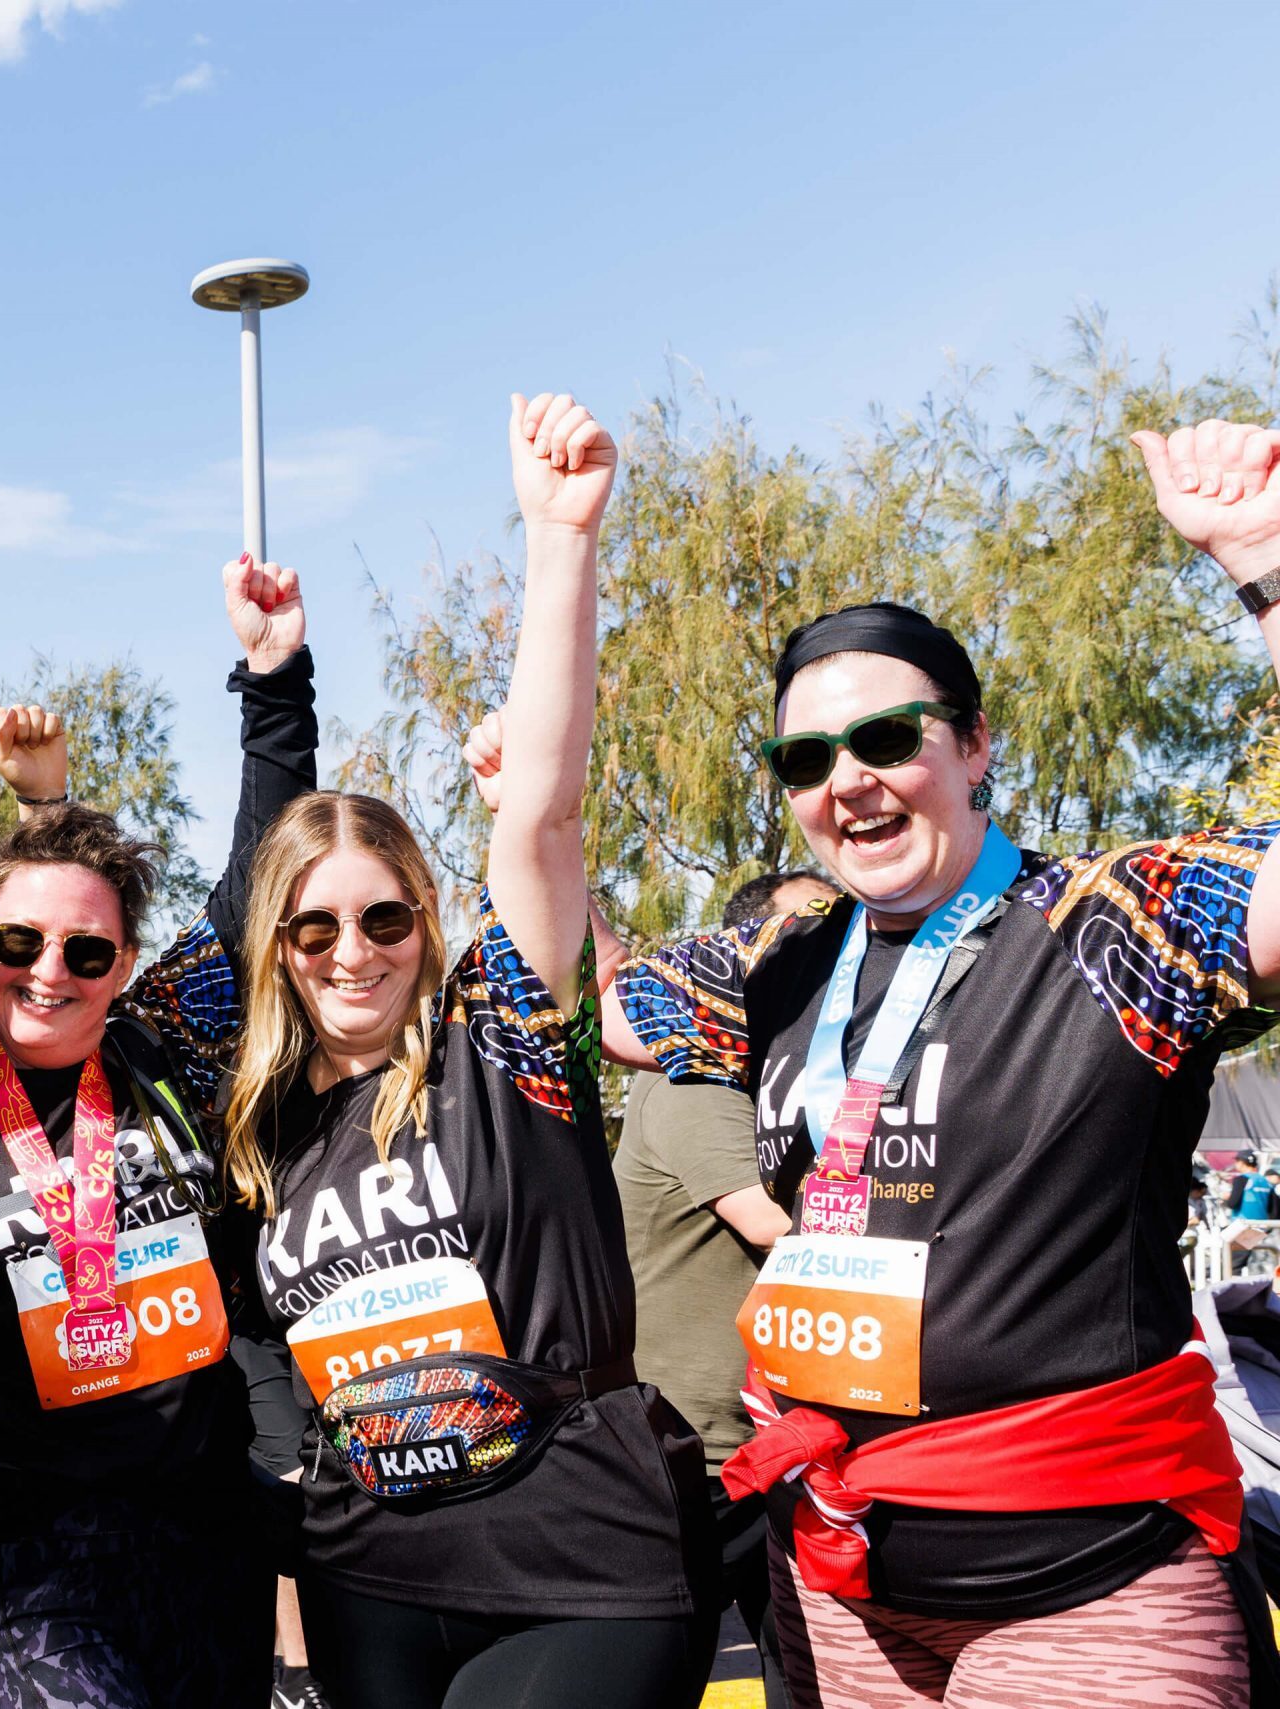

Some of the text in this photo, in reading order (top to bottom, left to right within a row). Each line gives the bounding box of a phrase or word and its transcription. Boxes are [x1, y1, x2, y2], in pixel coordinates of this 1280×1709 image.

[88, 1149, 115, 1198] C2S
[42, 1171, 71, 1223] C2S
[808, 1191, 863, 1213] CITY2
[257, 1143, 458, 1295] KARI
[811, 1210, 859, 1228] SURF
[275, 1223, 469, 1318] FOUNDATION
[775, 1249, 888, 1280] CITY2SURF
[312, 1275, 449, 1326] CITY2SURF
[70, 1320, 124, 1343] CITY2
[753, 1304, 882, 1361] 81898
[77, 1339, 123, 1358] SURF
[186, 1346, 211, 1362] 2022
[71, 1375, 120, 1396] ORANGE
[848, 1387, 883, 1402] 2022
[378, 1444, 458, 1477] KARI
